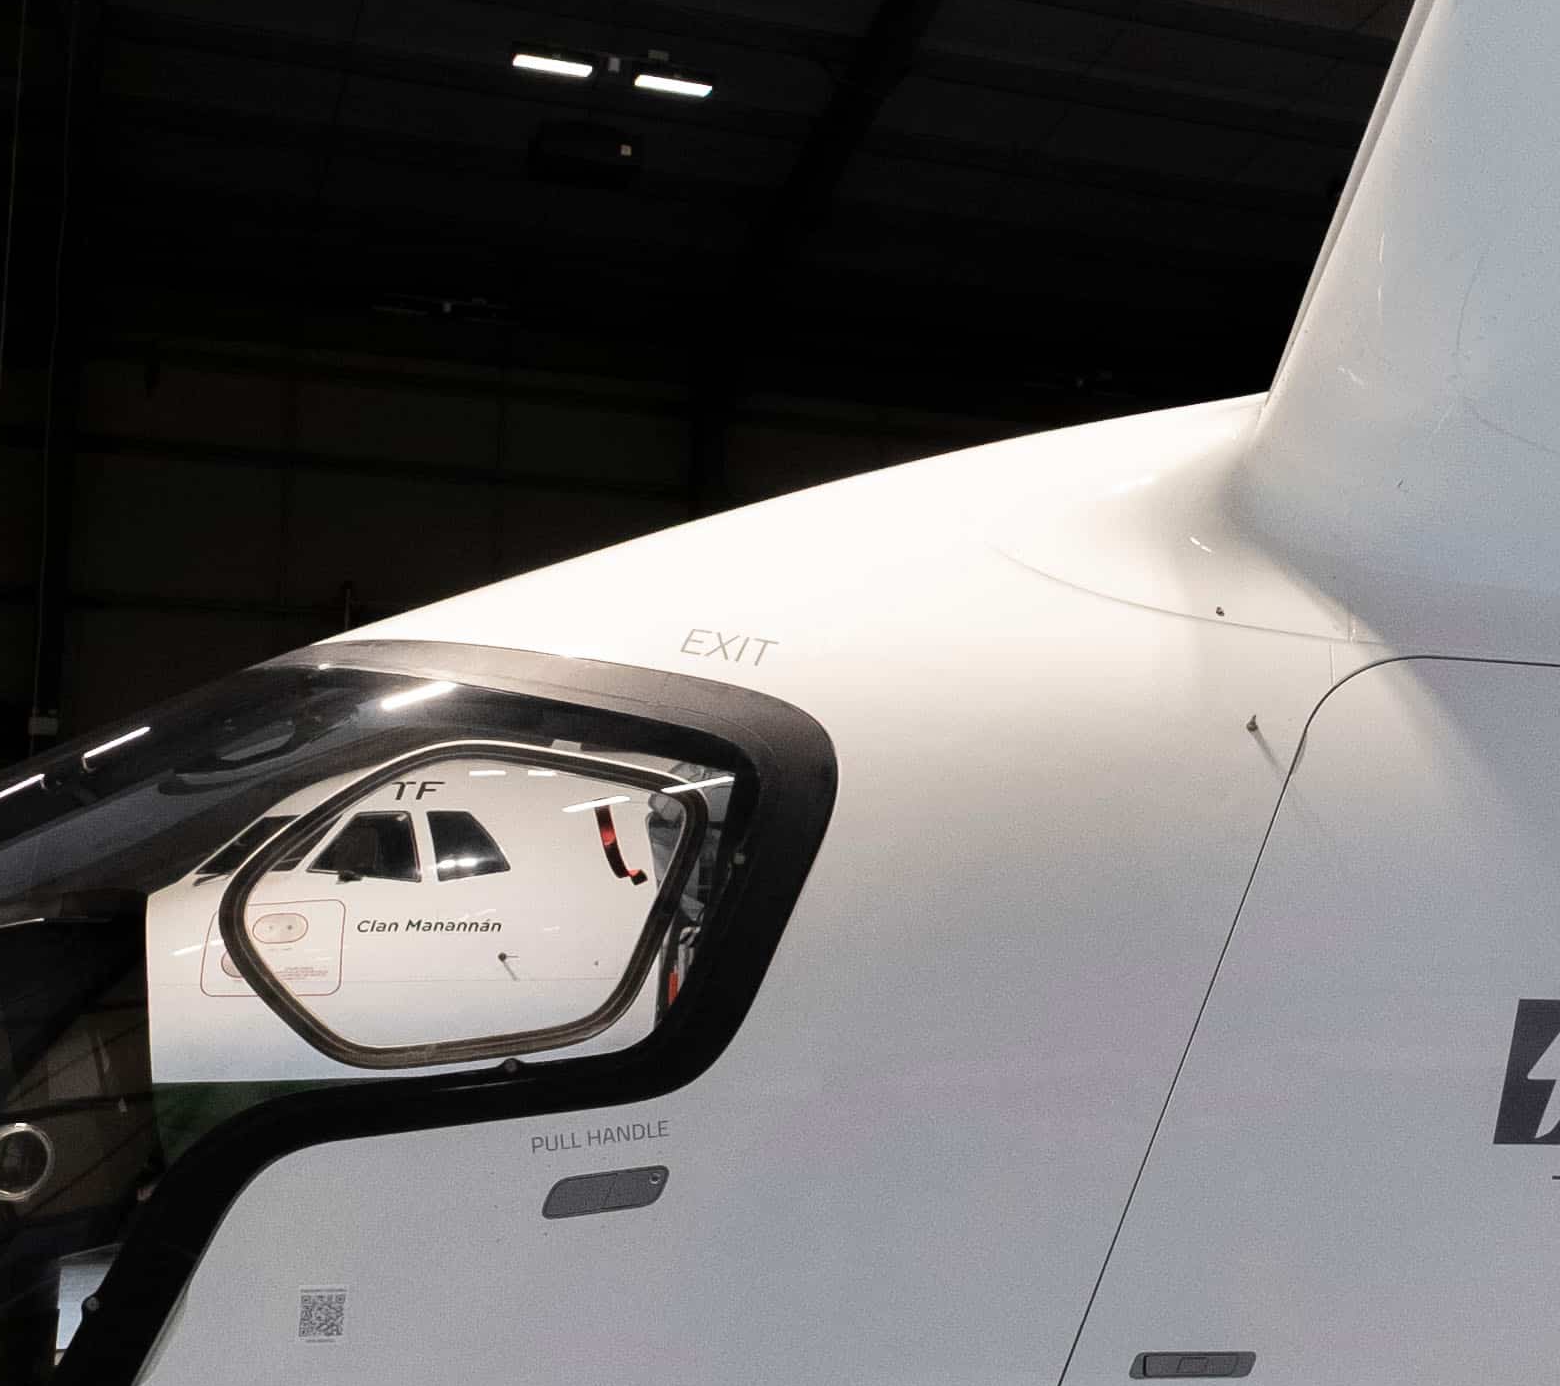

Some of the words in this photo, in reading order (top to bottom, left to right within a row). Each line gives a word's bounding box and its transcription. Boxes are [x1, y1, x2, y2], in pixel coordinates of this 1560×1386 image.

[680, 628, 780, 667] EXIT
[391, 781, 446, 801] TF
[356, 919, 399, 933] Clan
[405, 918, 502, 933] Manannán
[531, 1132, 582, 1154] PULL
[587, 1120, 670, 1147] HANDLE
